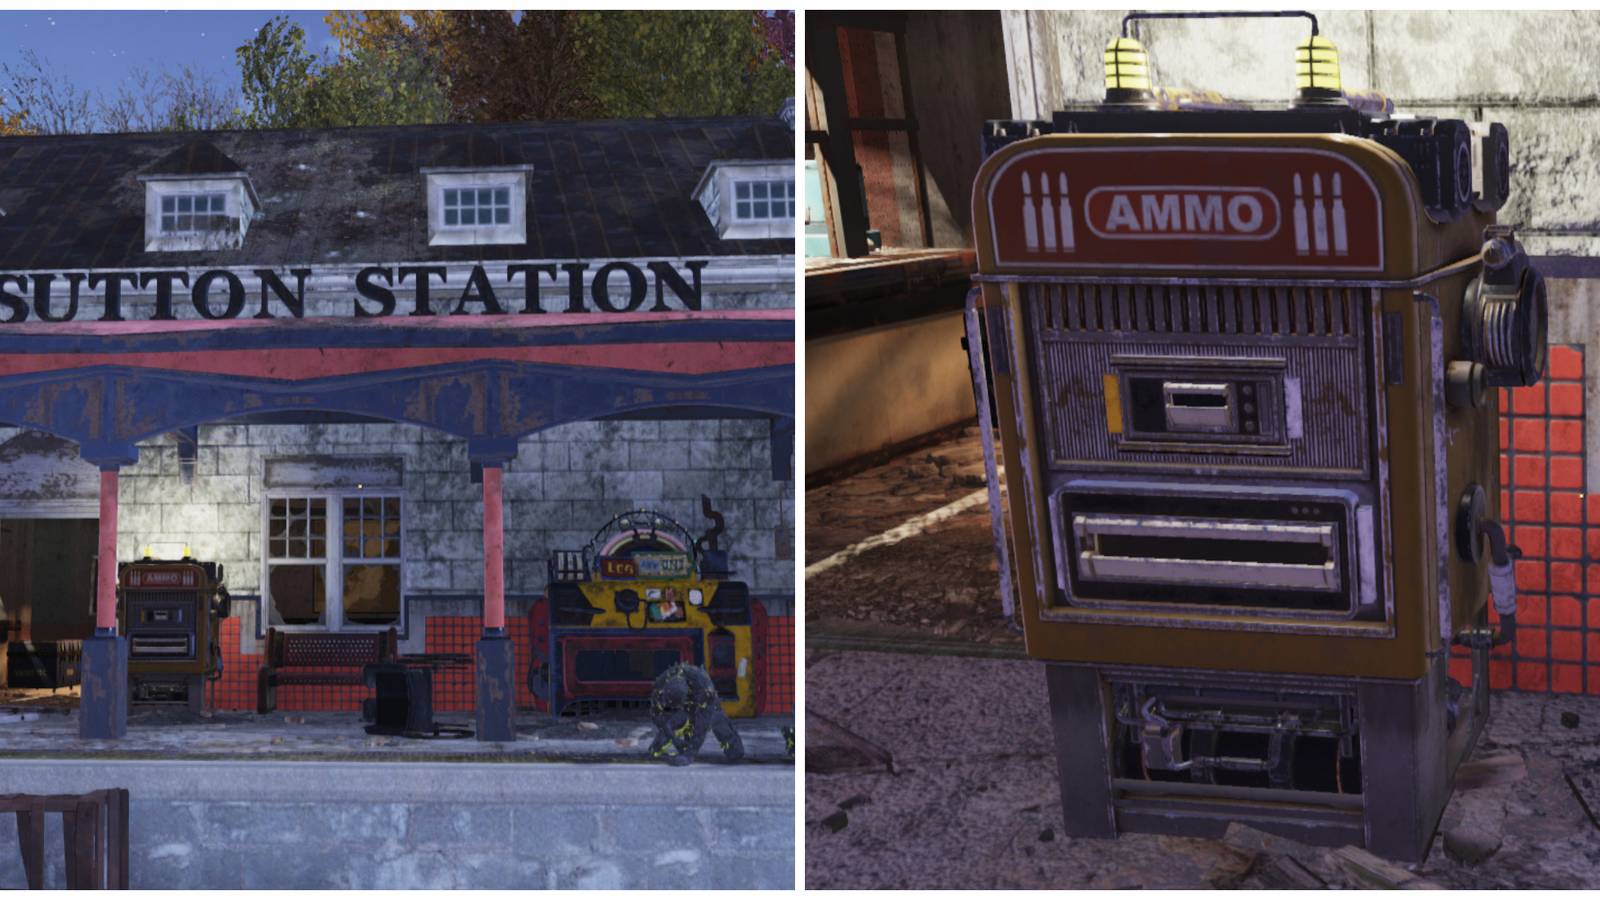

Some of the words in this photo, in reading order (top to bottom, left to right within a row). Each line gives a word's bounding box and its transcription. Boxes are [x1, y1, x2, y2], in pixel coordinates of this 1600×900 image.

[1104, 193, 1264, 233] AMMO
[0, 268, 312, 324] SUTTON
[353, 260, 709, 317] STATION
